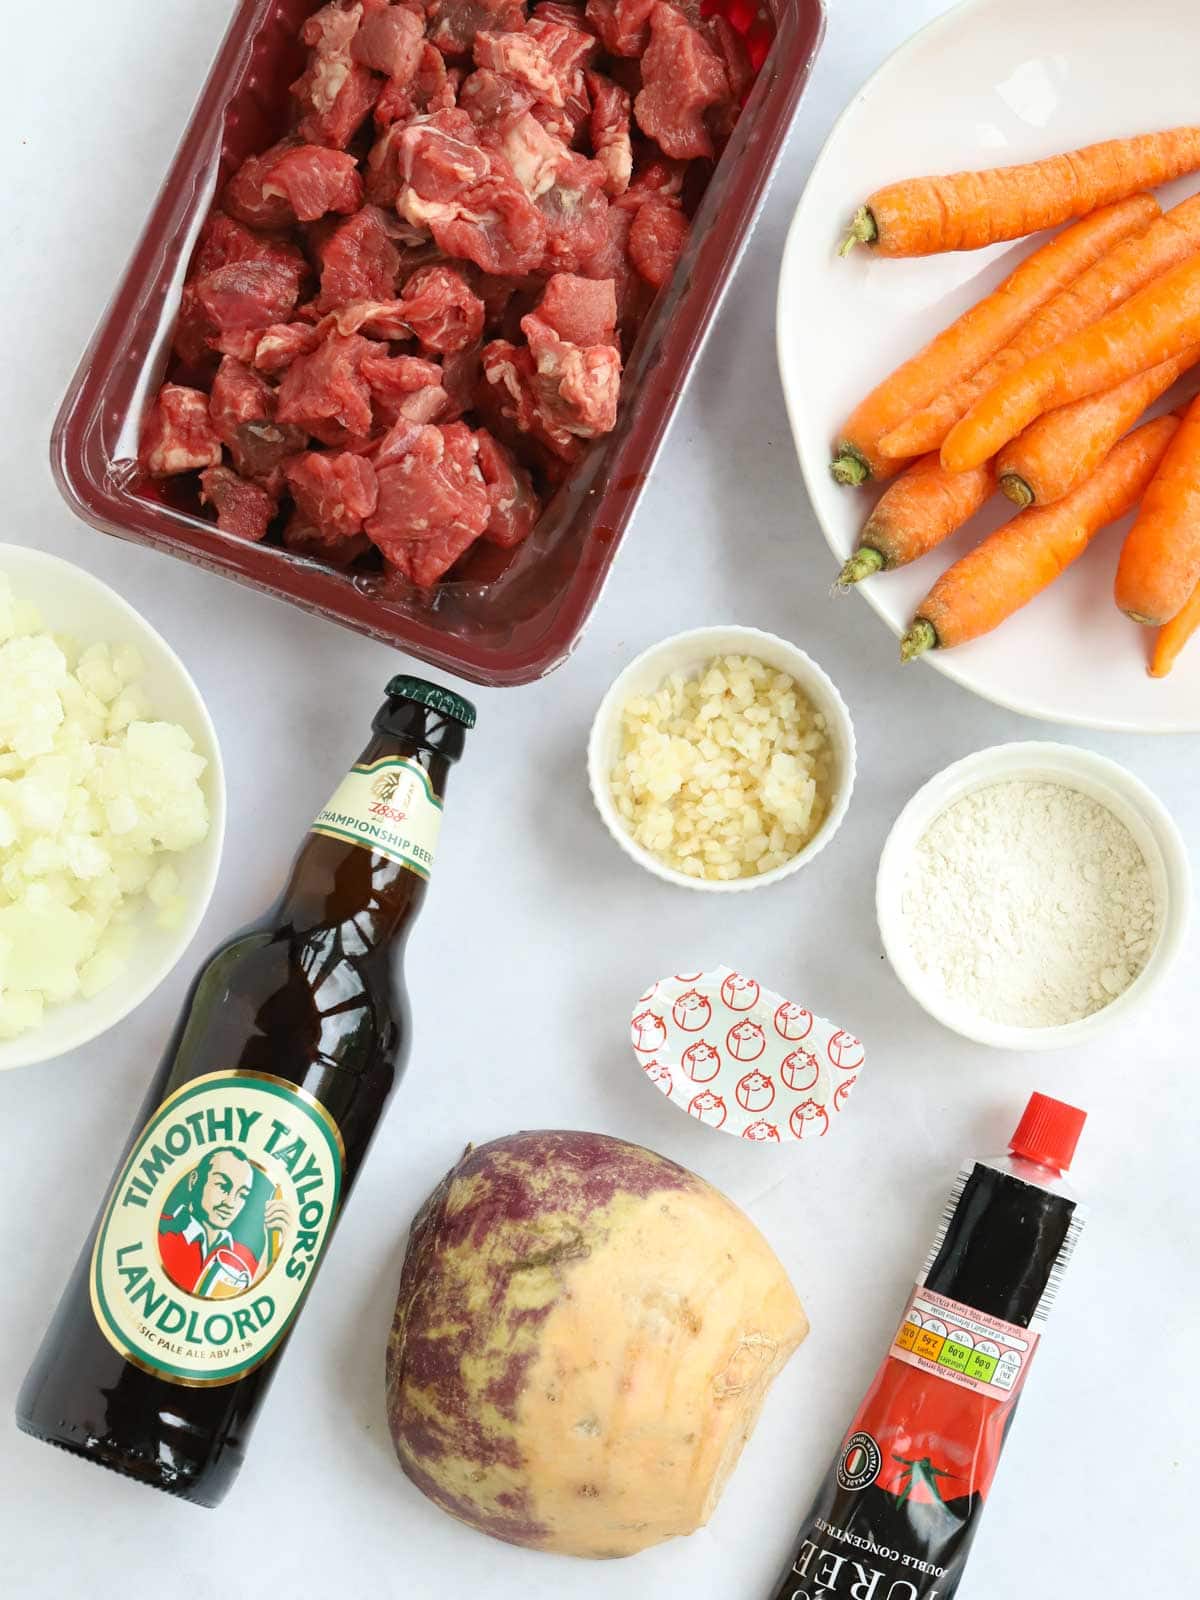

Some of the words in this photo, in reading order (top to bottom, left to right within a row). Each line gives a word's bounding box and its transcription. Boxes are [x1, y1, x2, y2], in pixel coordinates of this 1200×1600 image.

[319, 810, 410, 850] CHAMPIONSHIP
[368, 801, 408, 823] 1858
[122, 1106, 262, 1209] TIMOTHY
[263, 1118, 324, 1282] TAYLOR'S
[116, 1241, 276, 1346] LANDLORD
[137, 1323, 157, 1342] SIC
[157, 1338, 183, 1355] PALE
[185, 1348, 206, 1359] ALE
[208, 1347, 230, 1359] ABV
[921, 1333, 938, 1348] 2.6g
[947, 1344, 965, 1359] 0.0g
[973, 1355, 991, 1369] 0.0g
[815, 1517, 899, 1561] CONCENTRATE
